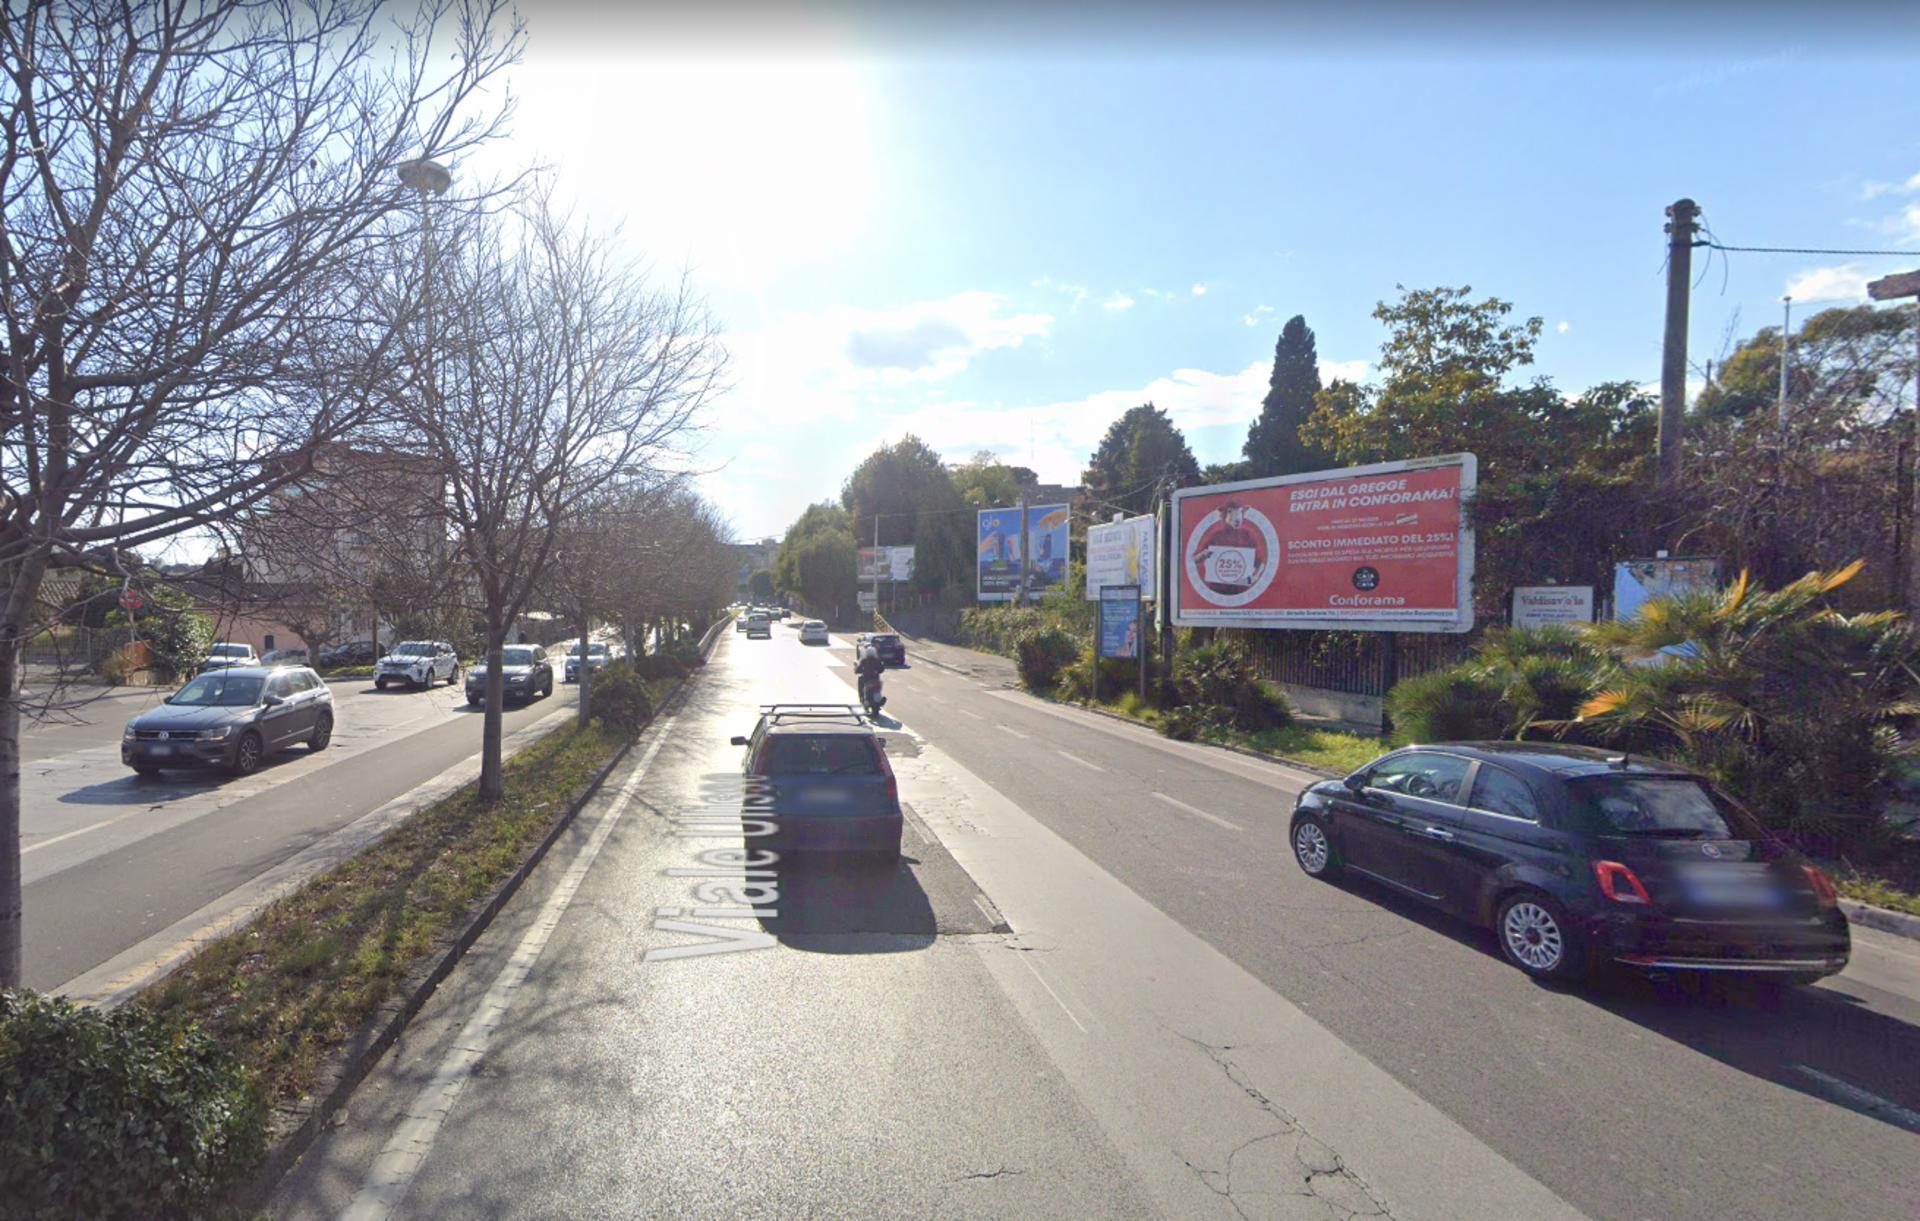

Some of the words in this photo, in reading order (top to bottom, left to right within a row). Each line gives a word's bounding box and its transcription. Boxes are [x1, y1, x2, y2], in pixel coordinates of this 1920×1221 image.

[1290, 488, 1319, 500] ESCI
[1320, 485, 1345, 498] DAL
[1348, 479, 1408, 495] GREGGE
[1289, 499, 1329, 513] ENTRA
[1332, 497, 1347, 510] IN
[1349, 487, 1456, 508] CONFORAMA!
[982, 513, 1000, 531] glo
[1288, 540, 1331, 550] SCONTO
[1333, 535, 1399, 548] IMMEDIATO
[1402, 533, 1424, 545] DEL
[1329, 594, 1406, 607] Conforama
